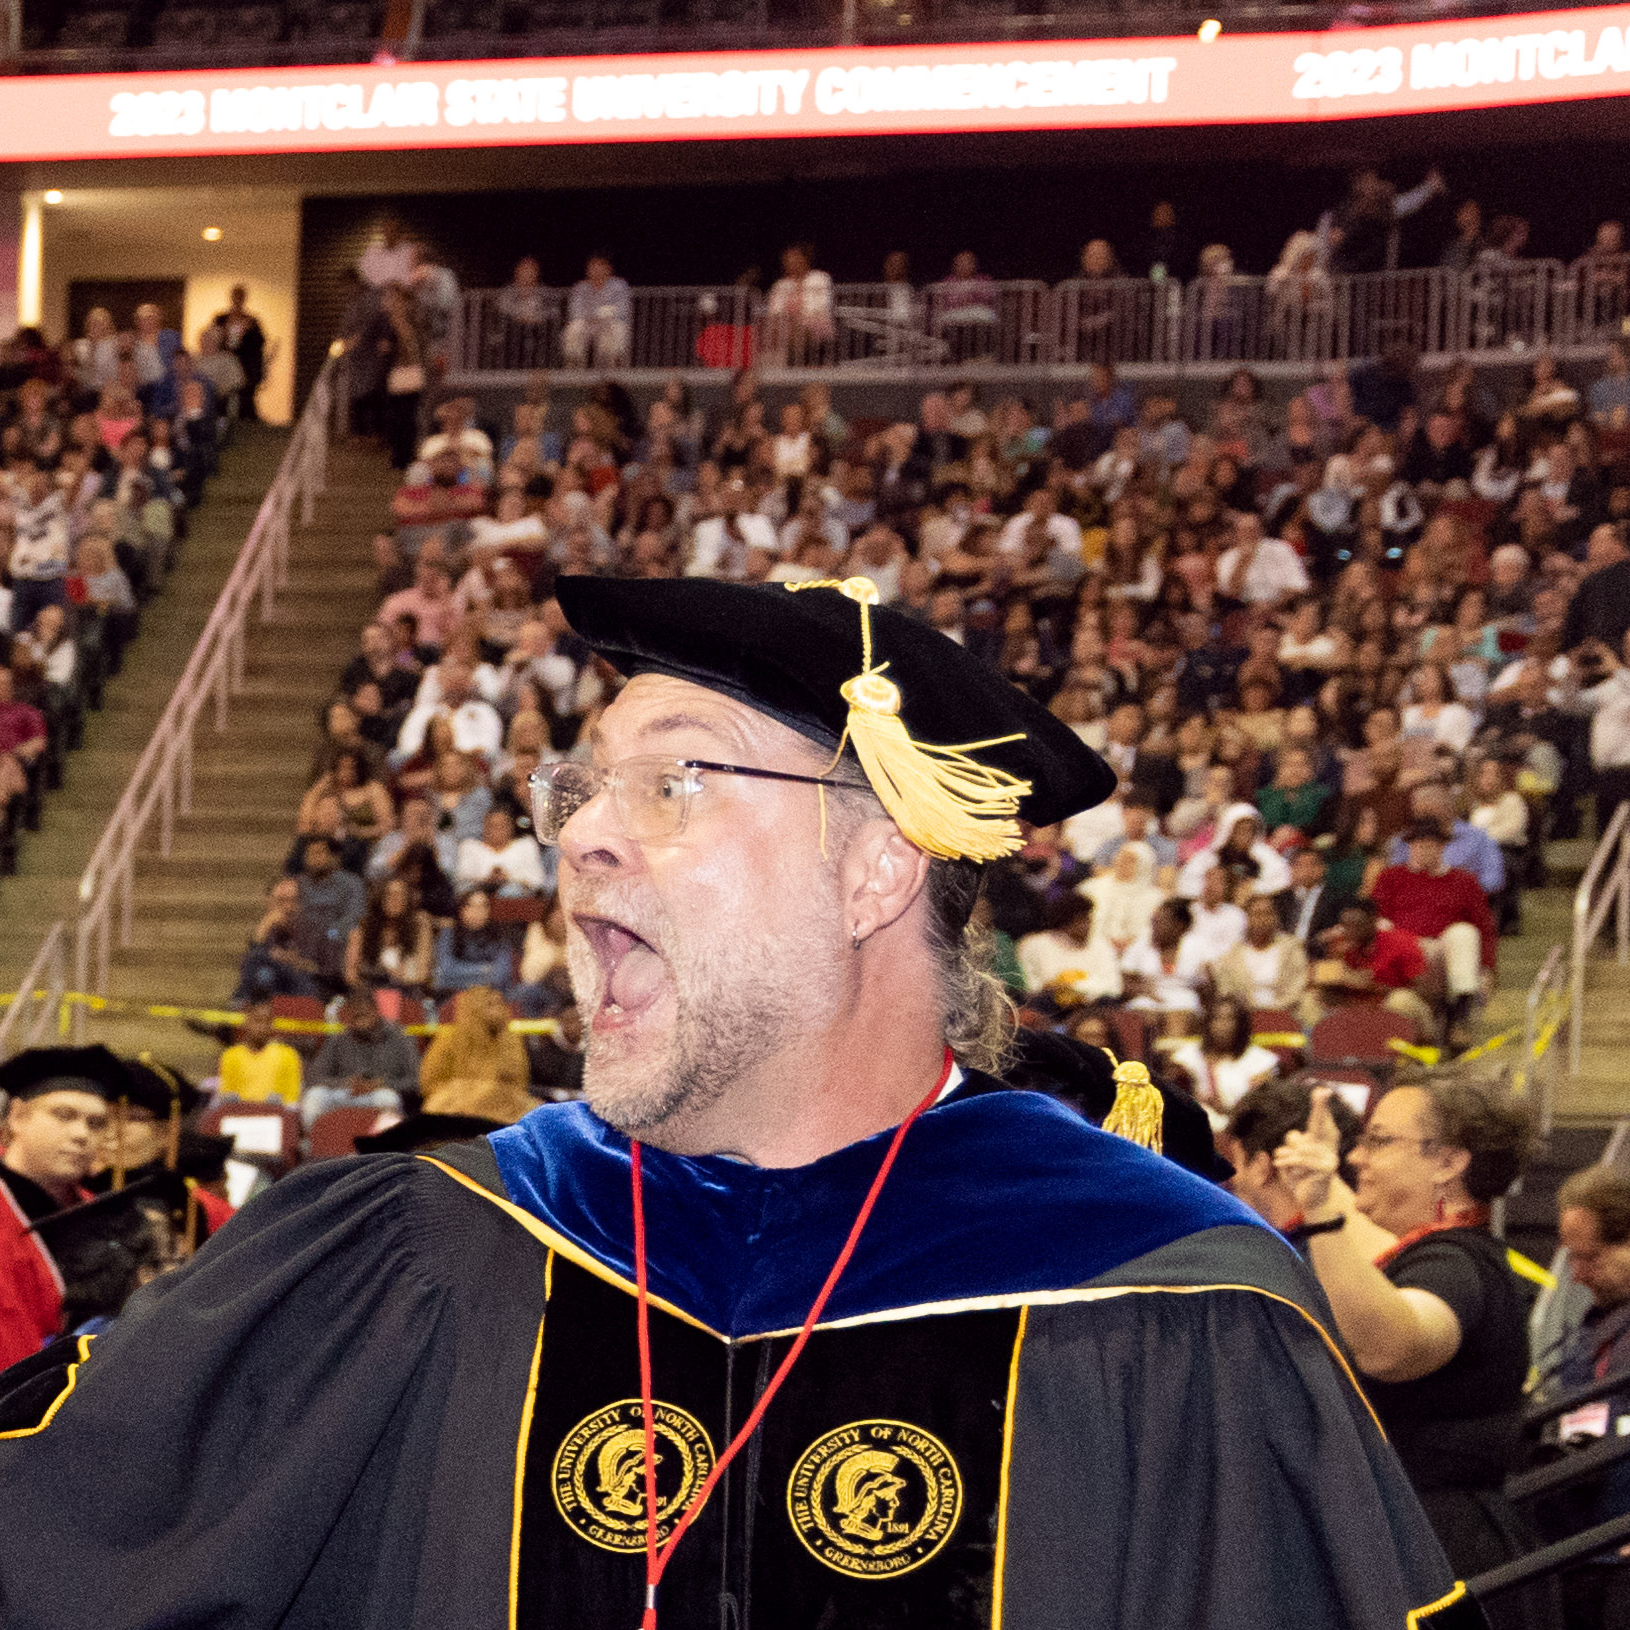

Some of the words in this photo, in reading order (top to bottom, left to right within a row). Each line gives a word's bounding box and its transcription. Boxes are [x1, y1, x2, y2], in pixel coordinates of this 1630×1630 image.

[1292, 46, 1403, 98] 2023
[1410, 26, 1630, 91] MONTCLA
[108, 89, 205, 137] 2023
[210, 82, 438, 133] MONTCLAIR
[443, 76, 566, 126] STATE
[572, 68, 810, 122] UNIVERSITY
[815, 57, 1176, 115] COMMENCEMENT
[654, 1407, 700, 1442] NORTH
[870, 1426, 895, 1440] OF
[558, 1408, 622, 1479] UNIVERSITY
[896, 1428, 946, 1467] NORTH
[794, 1428, 861, 1498] UNIVERSITY
[559, 1481, 578, 1512] THE
[925, 1467, 956, 1541] CAROLINA
[794, 1500, 815, 1533] THE
[886, 1522, 910, 1534] 1891
[824, 1546, 912, 1573] GREENSBORO
